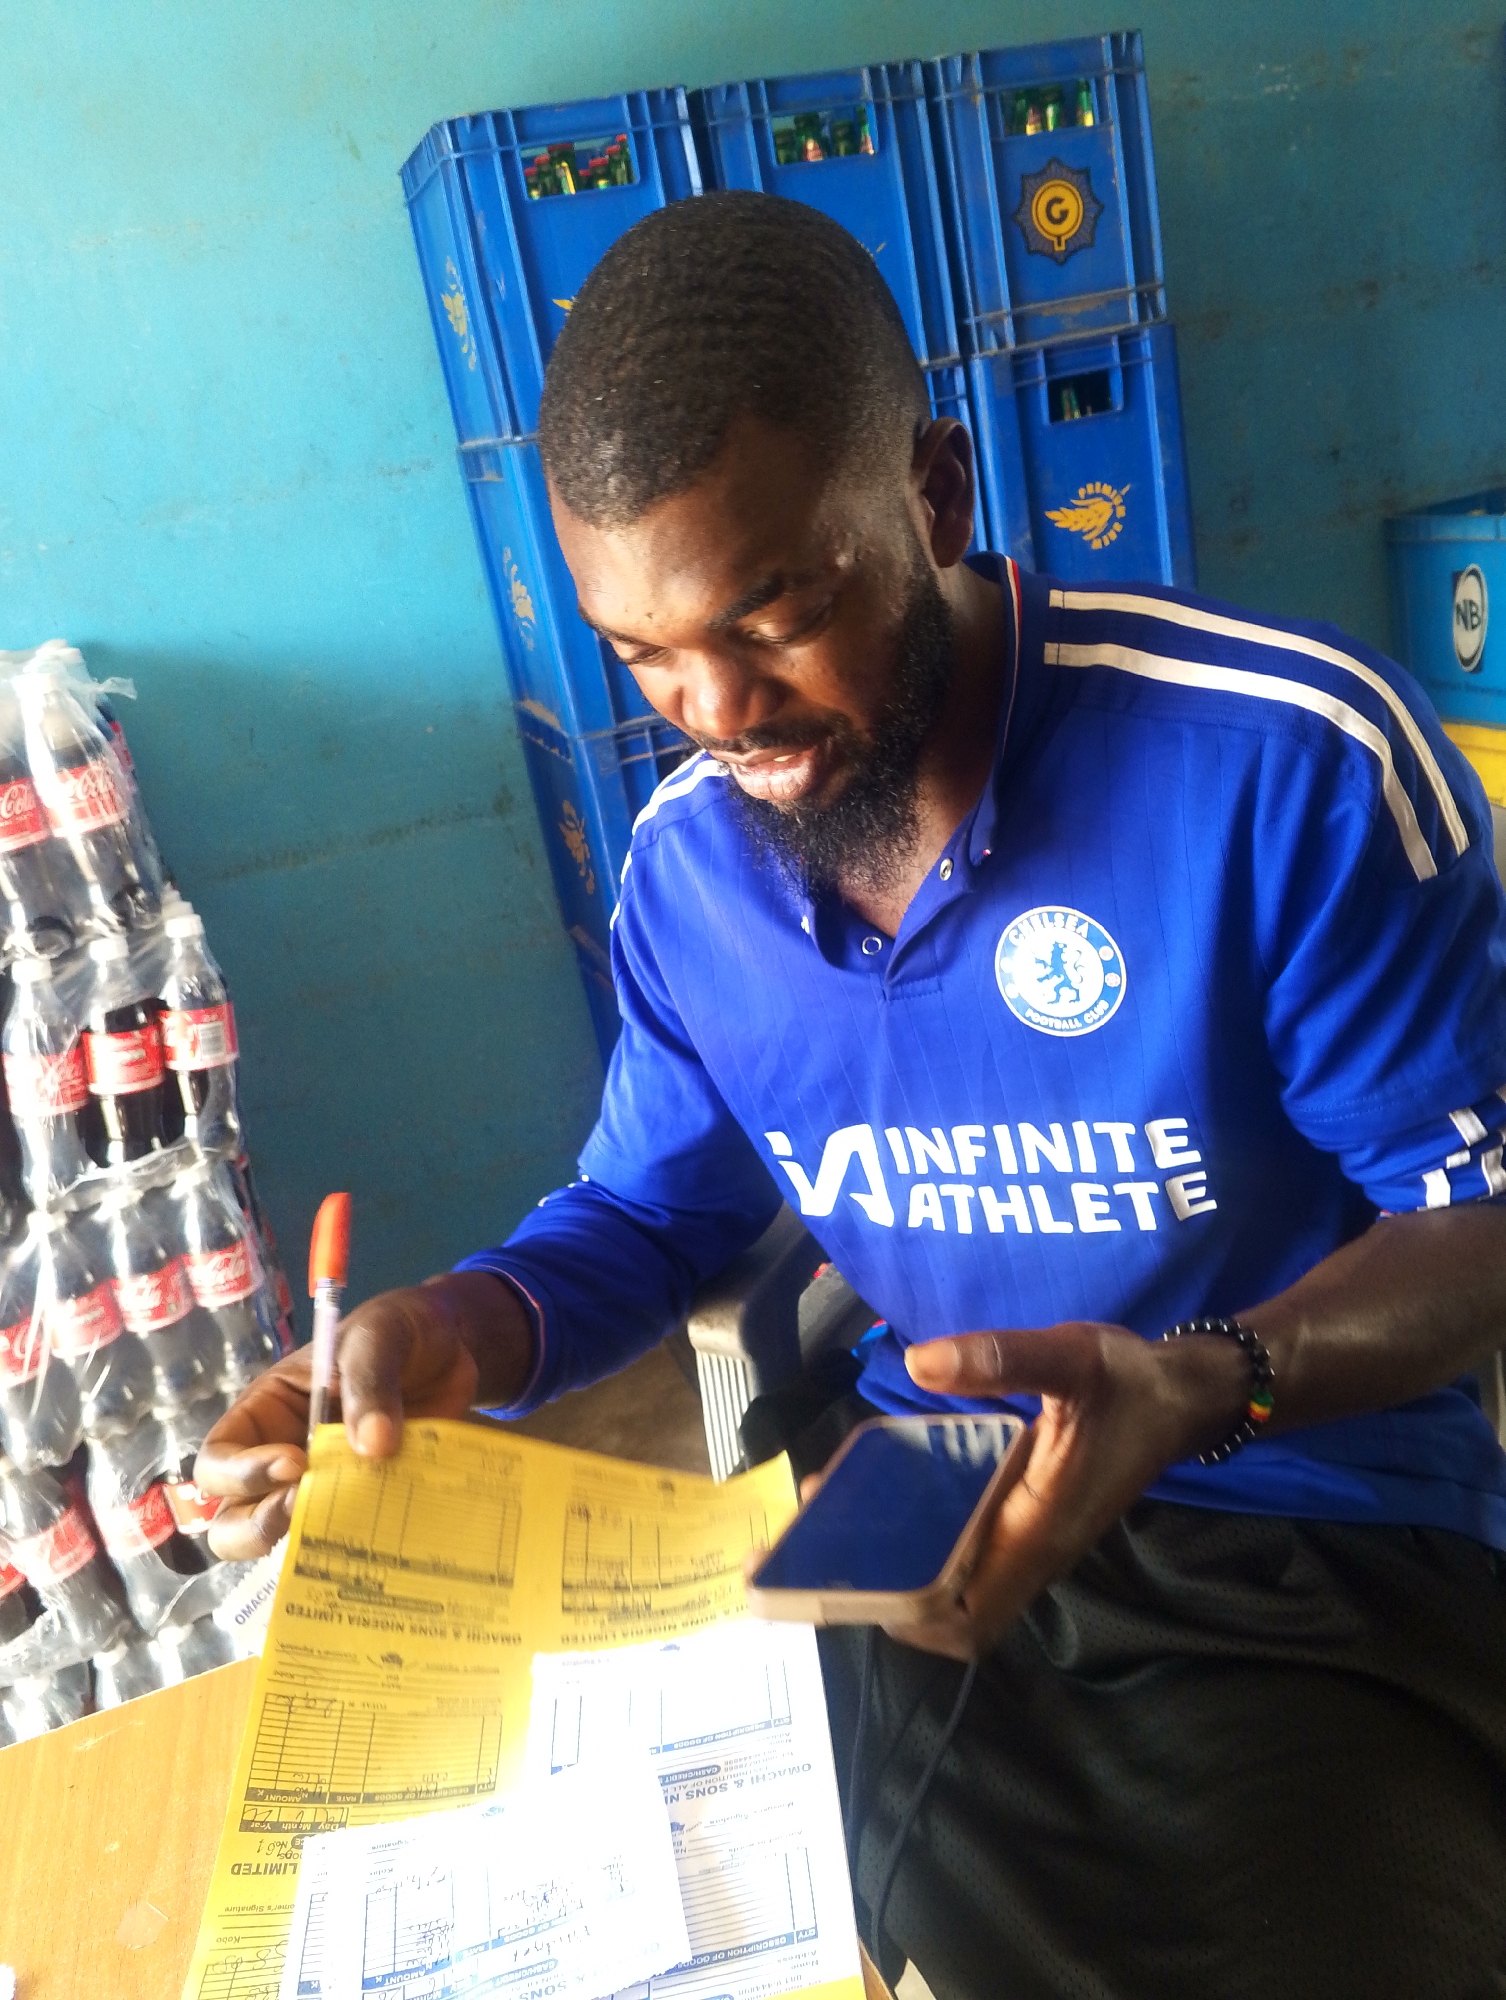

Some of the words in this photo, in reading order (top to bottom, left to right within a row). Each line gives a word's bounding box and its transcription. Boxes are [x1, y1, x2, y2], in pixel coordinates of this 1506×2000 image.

[1045, 196, 1069, 225] G
[1455, 599, 1482, 631] NB
[1008, 912, 1089, 946] CHELSEA
[1025, 1008, 1082, 1030] FOOTBALL
[1083, 999, 1110, 1023] CLUB
[885, 1117, 1202, 1175] INFINITE
[908, 1171, 1217, 1234] ATHLETE
[235, 1579, 276, 1625] OMACHI
[285, 1603, 343, 1624] LIMITED
[348, 1614, 405, 1633] NIGERIA
[561, 1631, 617, 1645] LIMITED
[665, 1766, 718, 1782] CASH/CREDIT
[750, 1762, 812, 1786] OMACHI
[670, 1784, 688, 1792] ALL
[690, 1780, 703, 1789] OF
[733, 1779, 744, 1789] &
[375, 1793, 403, 1801] GOODS
[685, 1782, 729, 1800] SONS
[264, 1794, 301, 1802] AMOUNT
[663, 1792, 680, 1805] NI
[251, 1822, 271, 1830] Year
[282, 1822, 311, 1831] Month
[318, 1822, 339, 1831] Day
[231, 1862, 298, 1875] LIMITED
[224, 1904, 265, 1913] Signature
[267, 1903, 295, 1912] omer's
[797, 1927, 816, 1939] QTY
[216, 1935, 241, 1945] Kobo
[727, 1934, 787, 1959] DESCRIPTION
[711, 1951, 725, 1963] OF
[375, 1975, 383, 1983] K
[383, 1968, 425, 1986] AMOUNT
[310, 1981, 319, 1990] K
[519, 1980, 566, 2000] SONS
